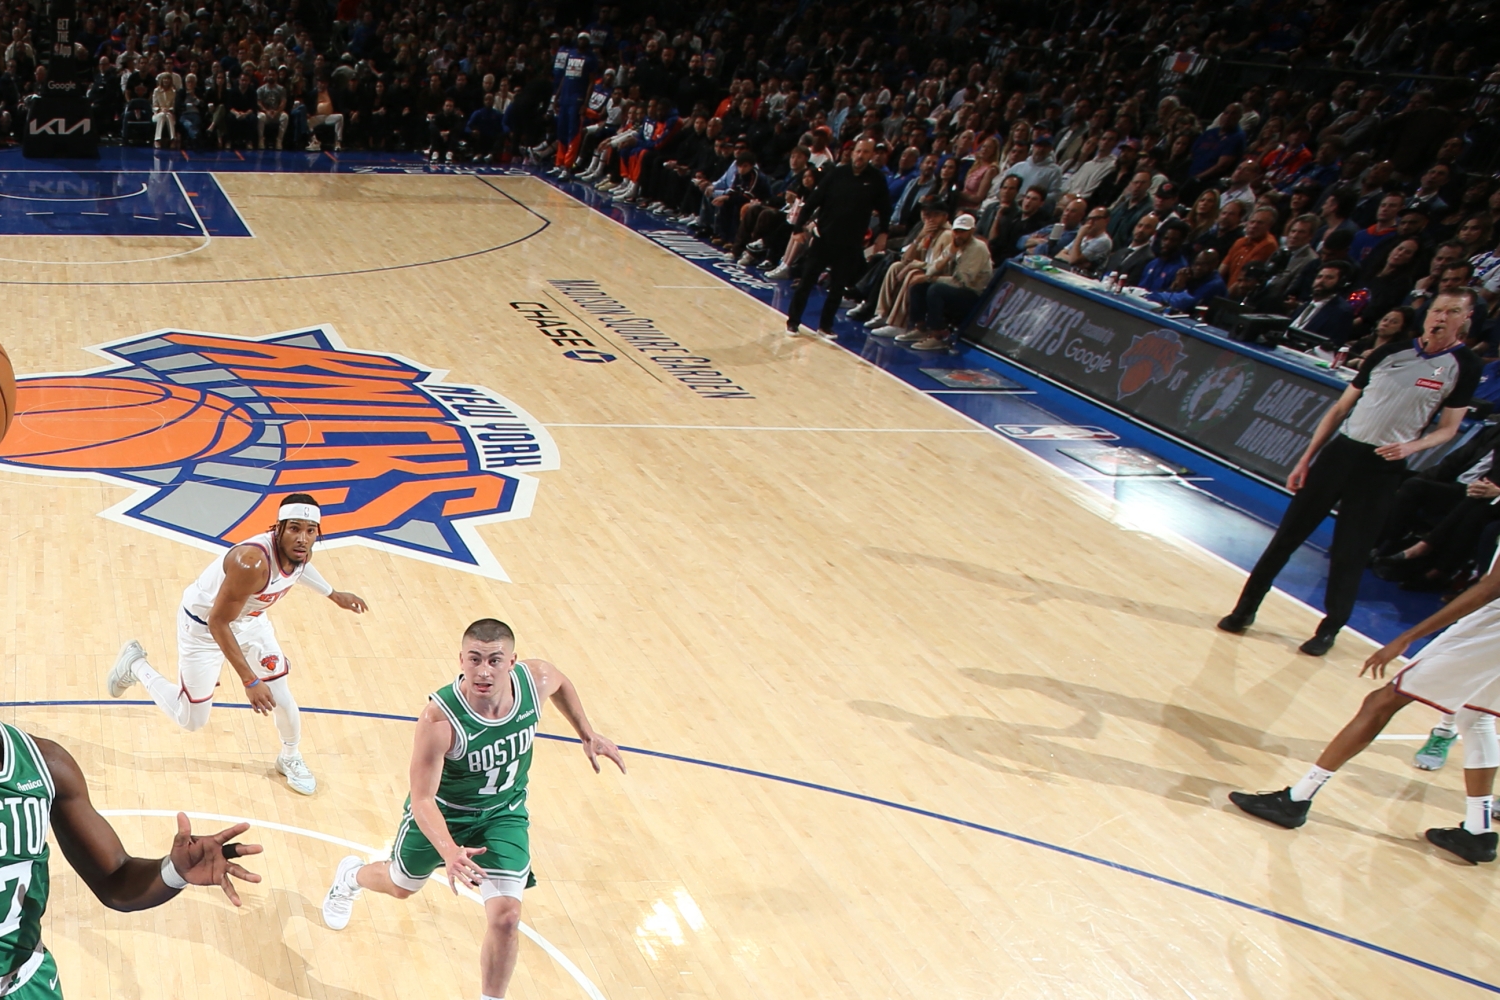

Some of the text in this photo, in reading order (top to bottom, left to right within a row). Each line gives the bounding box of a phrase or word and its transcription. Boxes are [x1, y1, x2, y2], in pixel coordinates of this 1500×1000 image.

[48, 80, 76, 91] Google
[509, 301, 597, 348] CHASE
[546, 279, 757, 399] MADISON SQUARE GARDEN
[988, 287, 1085, 357] PLAYOFFS
[1064, 337, 1112, 373] Google
[420, 384, 542, 468] NEW YORK
[1253, 379, 1317, 425] GAME
[1295, 394, 1331, 429] 7
[162, 332, 506, 543] KNICKS
[1234, 417, 1312, 467] MONDAY
[515, 708, 535, 723] Amica
[468, 721, 538, 773] BOSTON
[17, 779, 44, 792] Amica
[478, 759, 520, 795] 11
